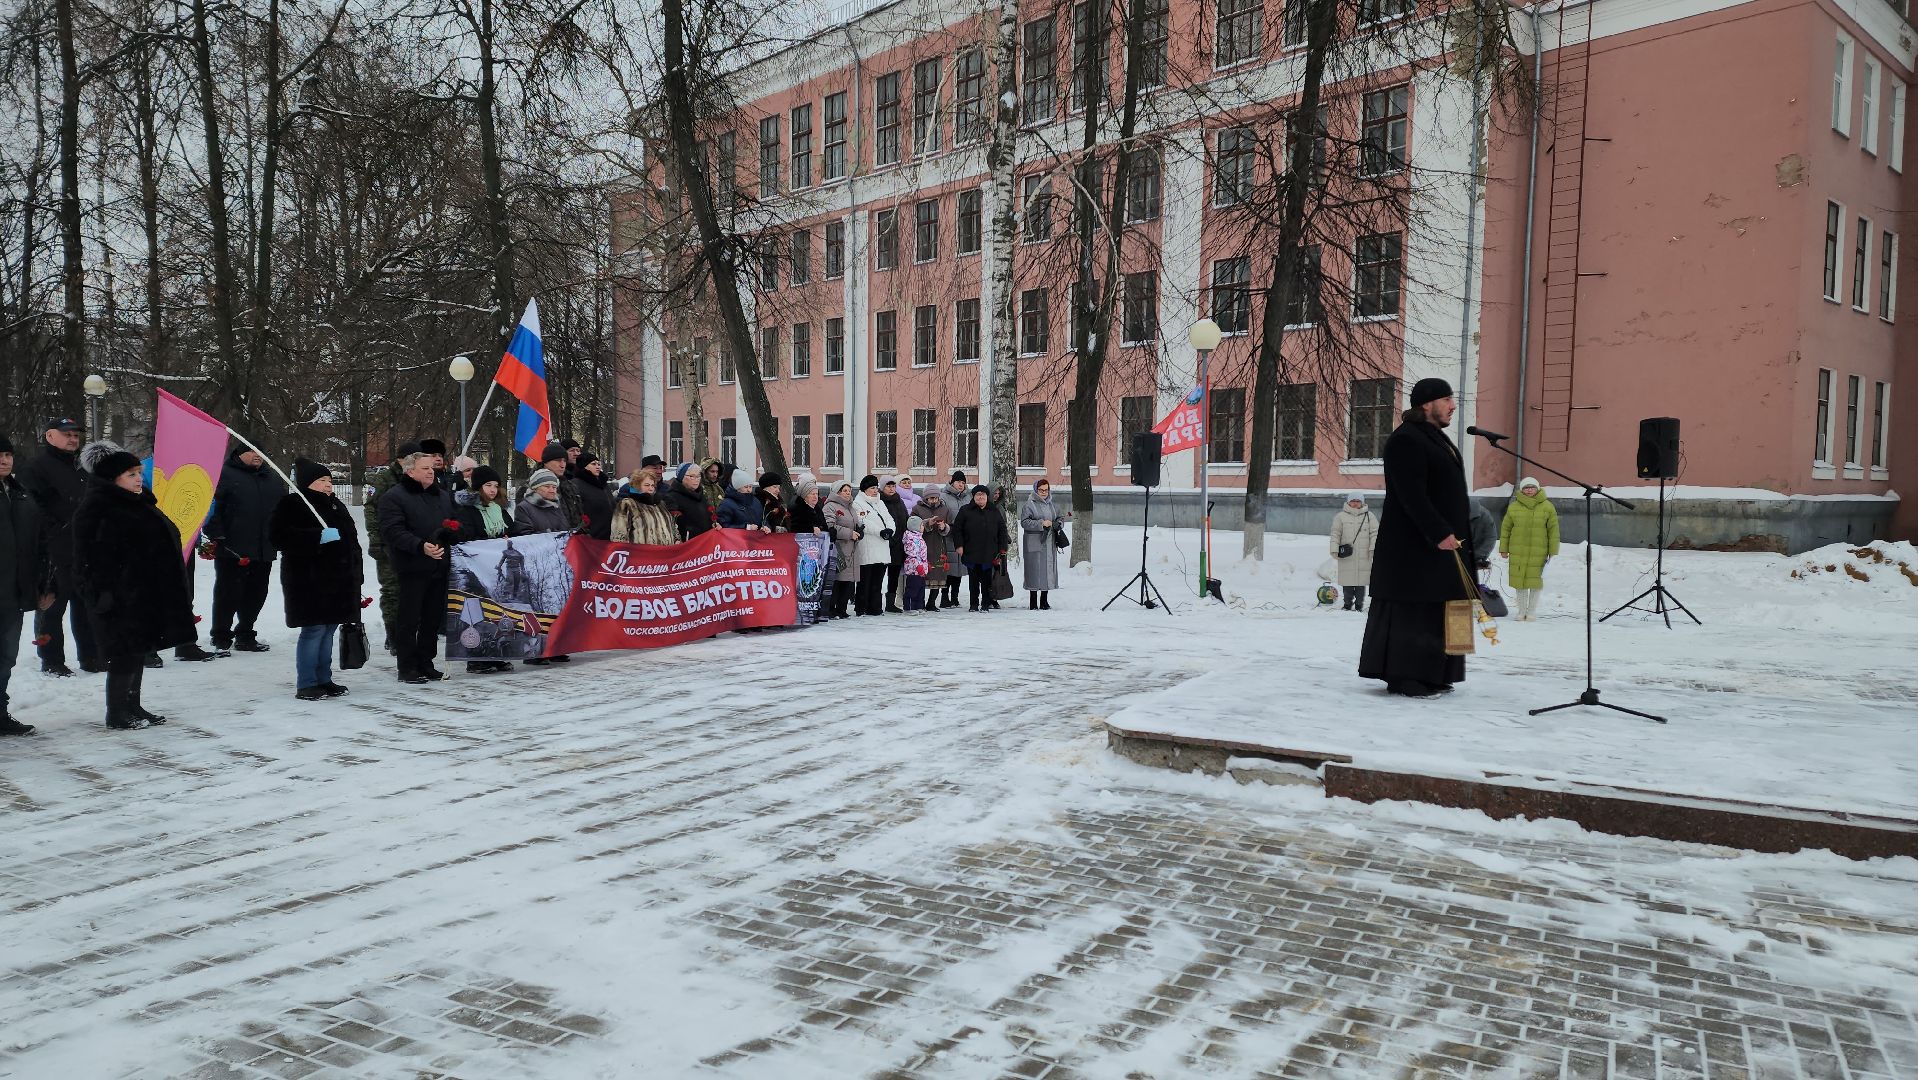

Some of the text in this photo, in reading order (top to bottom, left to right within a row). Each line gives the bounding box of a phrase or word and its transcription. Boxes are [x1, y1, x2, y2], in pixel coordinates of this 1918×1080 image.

[601, 551, 669, 574] Память
[700, 568, 744, 585] ОРНИЗАЦИЯ
[745, 567, 788, 576] ВЕТЕРАНОВ
[583, 596, 682, 620] «БОЕВОЕ
[682, 580, 790, 614] БРАТСТВО»
[678, 615, 713, 631] ОБЛАСТОЕ
[712, 606, 754, 622] ОТДЛЕНИЕ
